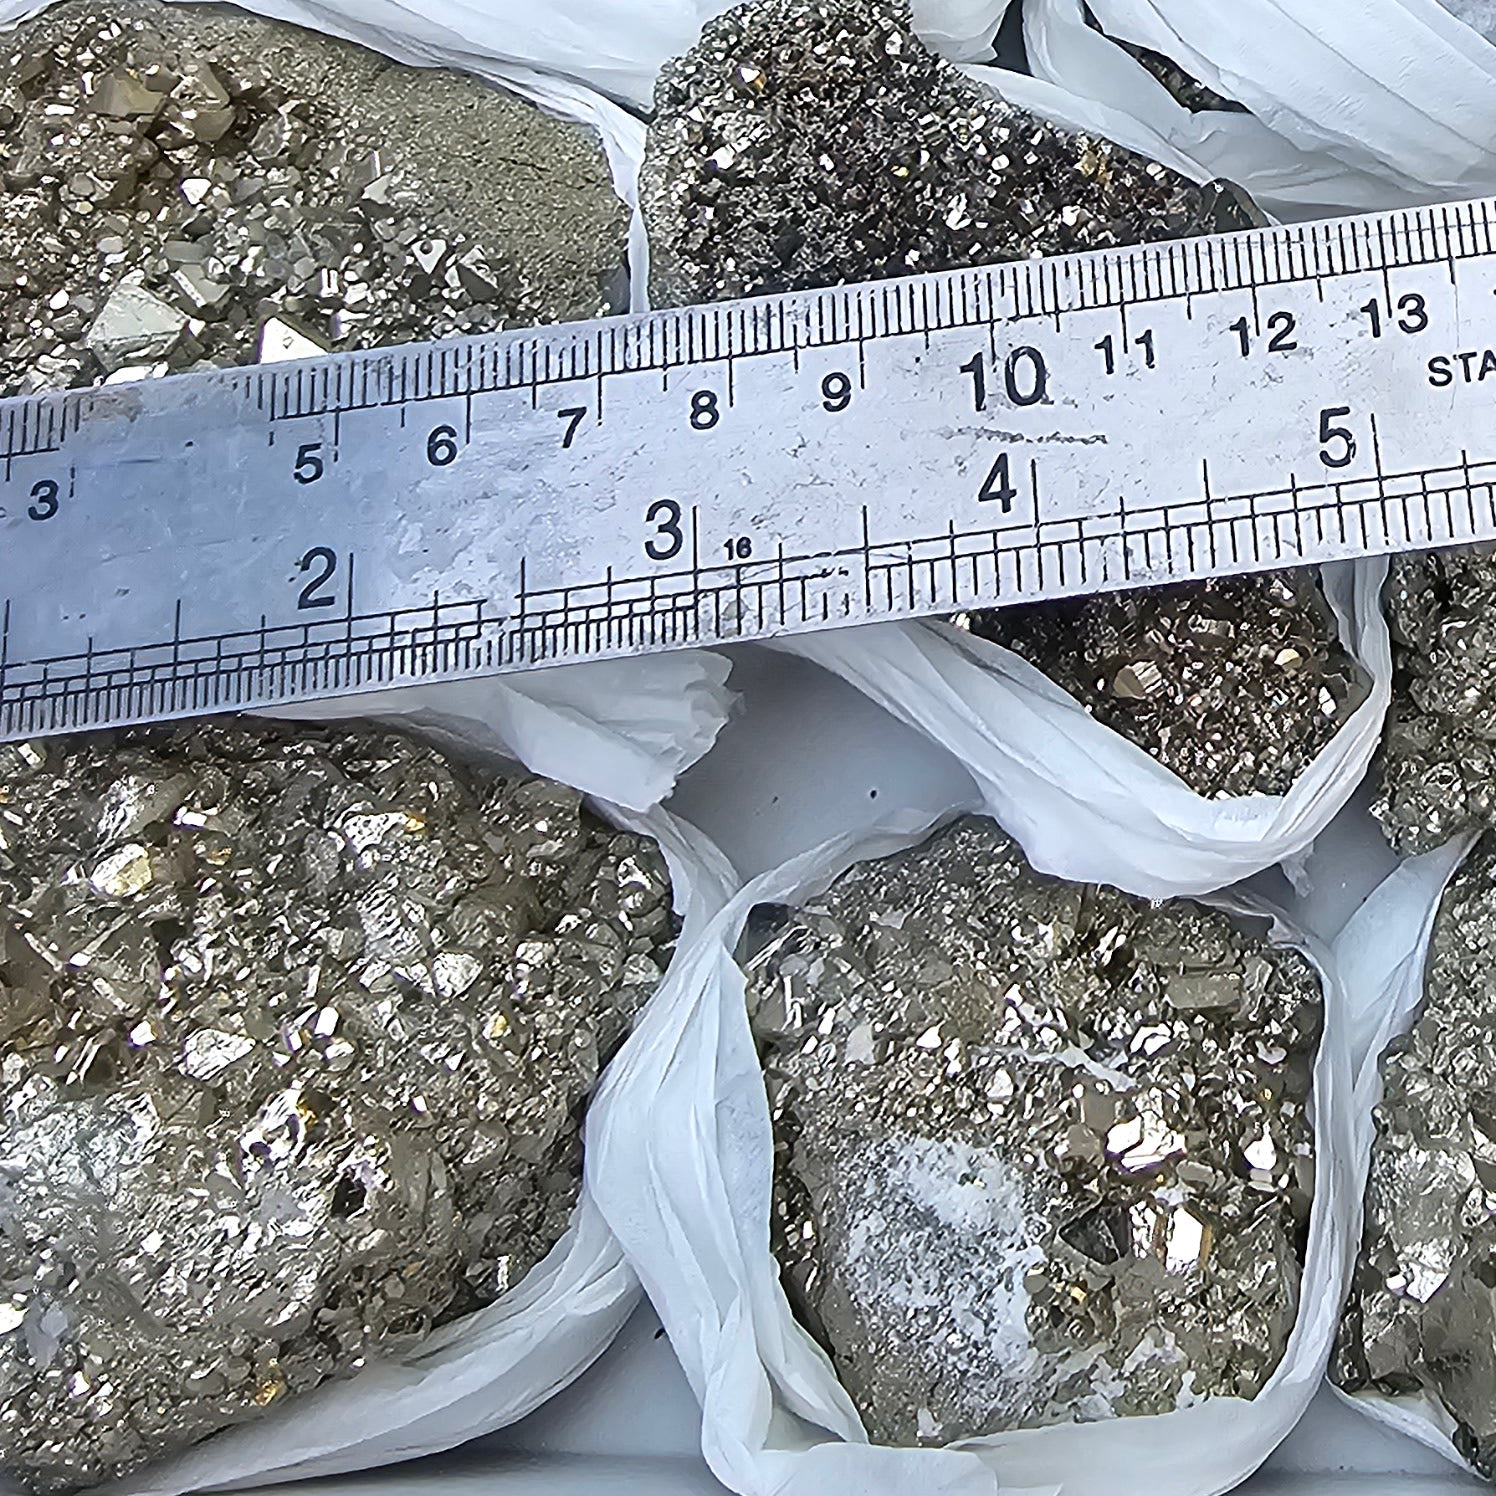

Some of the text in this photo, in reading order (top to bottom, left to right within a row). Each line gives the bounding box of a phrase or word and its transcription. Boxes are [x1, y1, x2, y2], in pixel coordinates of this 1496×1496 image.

[27, 479, 59, 521] 3
[293, 442, 324, 484] 5
[426, 425, 458, 466] 6
[556, 406, 588, 448] 7
[688, 389, 721, 430] 8
[821, 370, 852, 412] 9
[959, 345, 1050, 412] 10
[1094, 328, 1157, 375] 11
[1228, 310, 1299, 357] 12
[1361, 292, 1430, 339] 13
[297, 545, 337, 609] 2
[643, 498, 684, 561] 3
[978, 451, 1018, 514] 4
[1318, 406, 1357, 468] 5
[723, 536, 752, 560] 16
